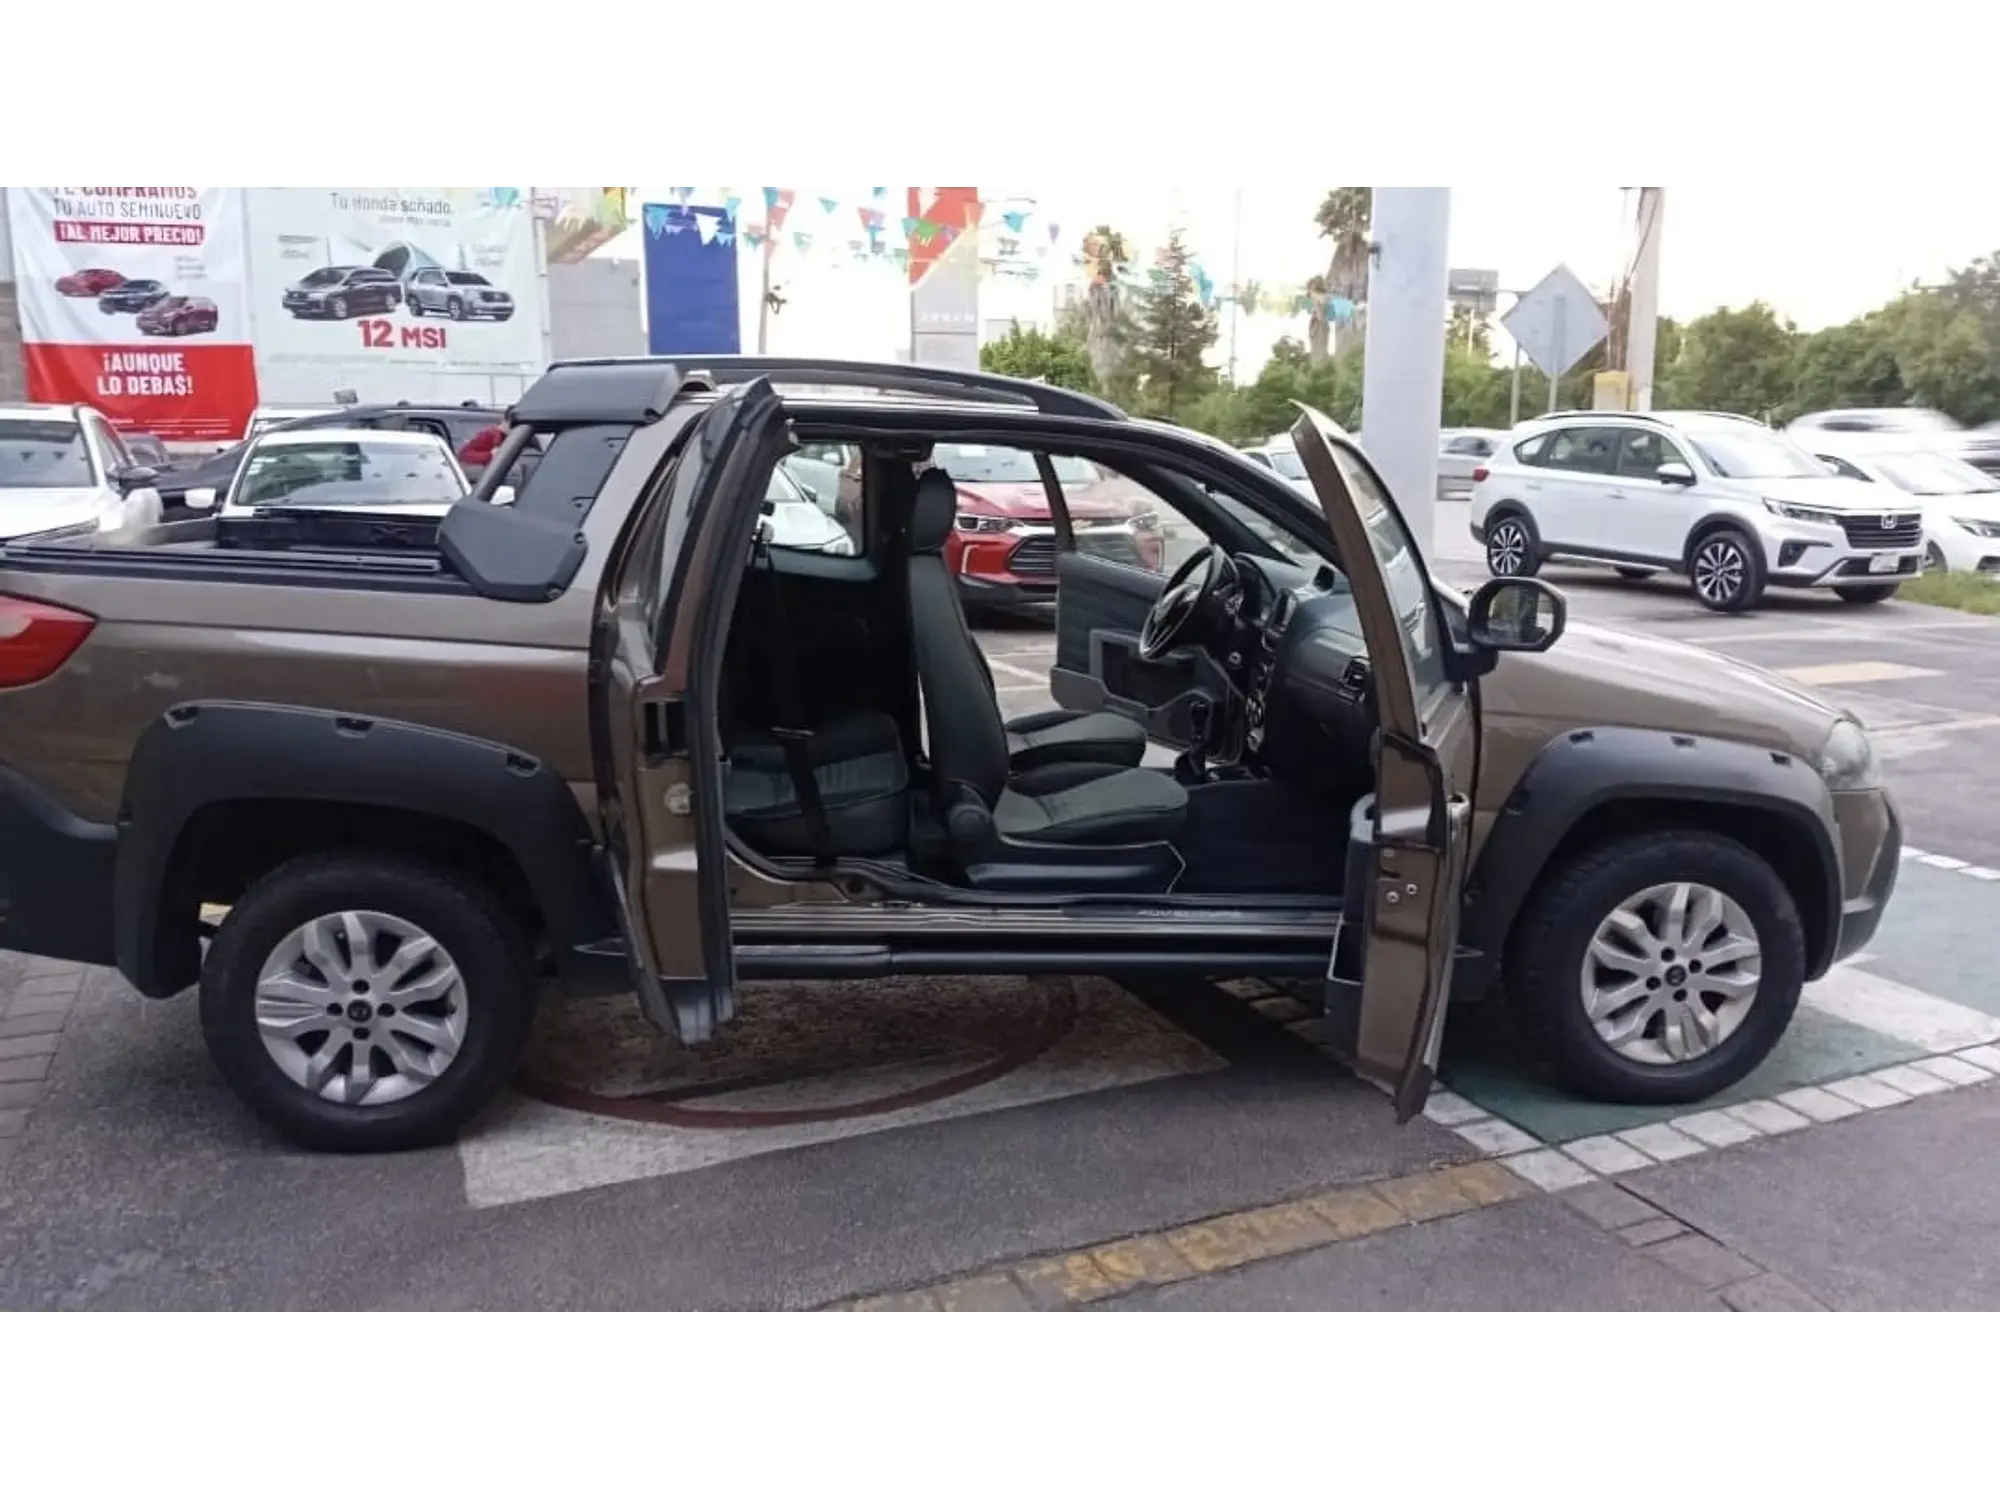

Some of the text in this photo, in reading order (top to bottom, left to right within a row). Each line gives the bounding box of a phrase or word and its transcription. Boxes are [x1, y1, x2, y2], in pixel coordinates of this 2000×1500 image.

[54, 198, 201, 219] TU AUTO SEMINUEVO
[330, 192, 348, 209] Tu
[352, 193, 398, 211] Honda
[90, 225, 141, 242] MEJOR
[143, 226, 201, 243] PRECIO!
[358, 320, 446, 348] 12 MSI
[104, 352, 184, 374] ¡AUNQUE
[97, 374, 194, 396] LO DEBAS!
